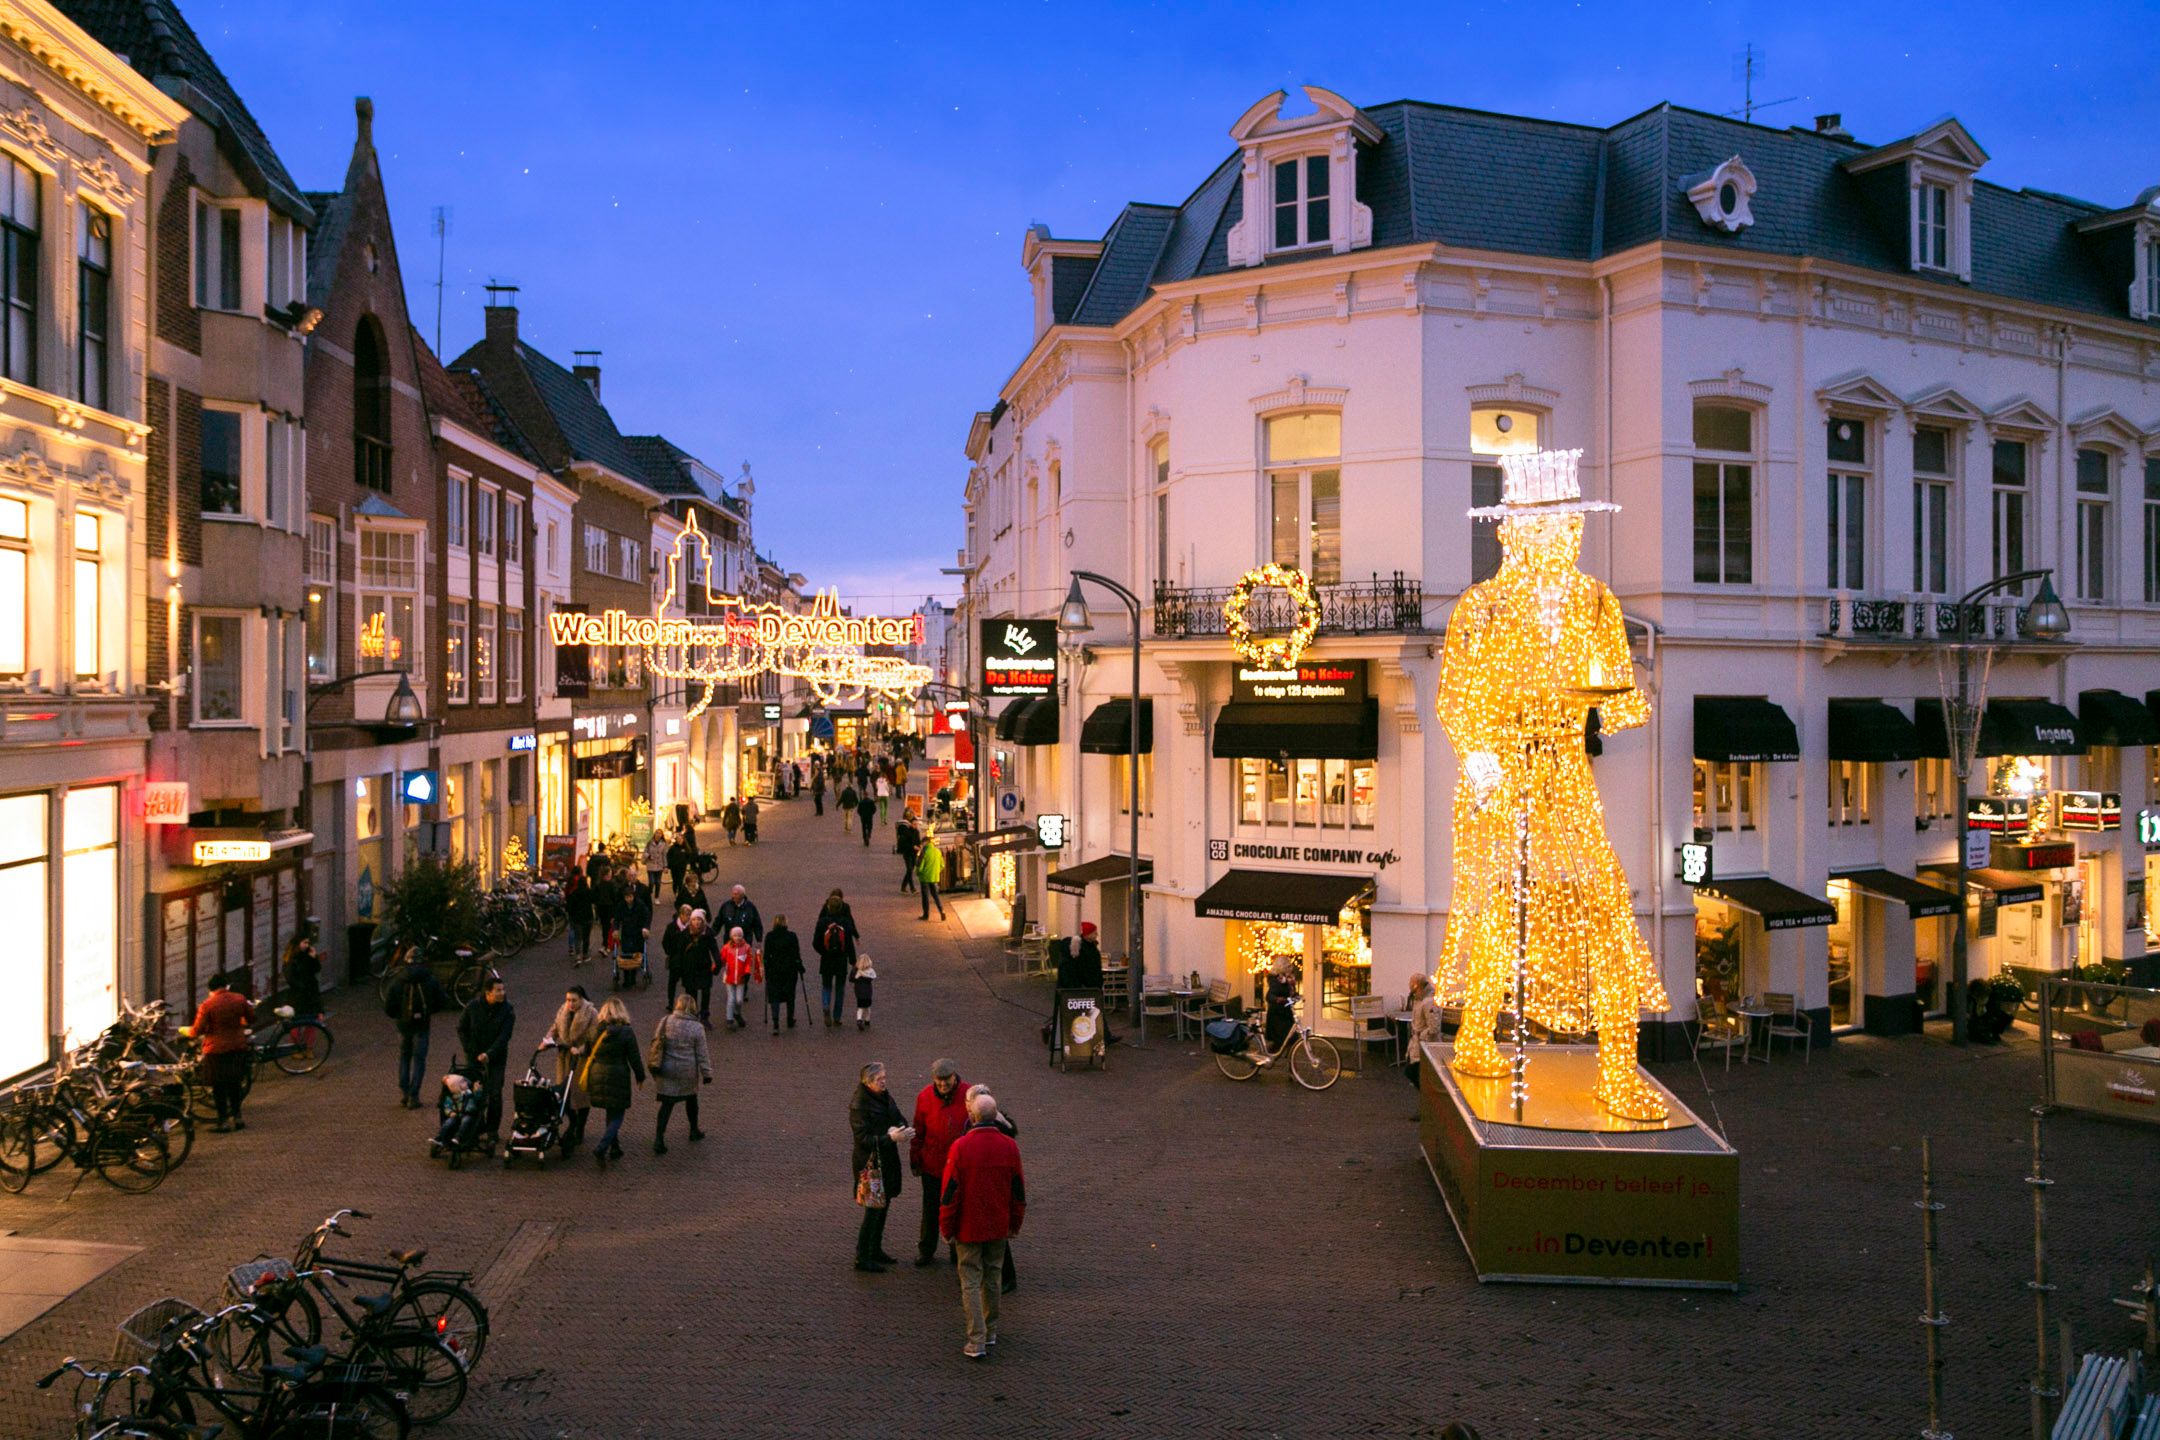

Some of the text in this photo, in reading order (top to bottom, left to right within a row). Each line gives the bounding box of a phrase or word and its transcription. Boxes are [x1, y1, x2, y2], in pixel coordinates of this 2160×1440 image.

[986, 669, 1055, 684] De Keizer
[1301, 668, 1316, 681] De
[1318, 668, 1355, 681] Keizer
[1264, 685, 1286, 699] etage
[1287, 685, 1301, 696] 125
[2035, 725, 2075, 744] Ingang
[1210, 840, 1227, 850] CH
[1211, 850, 1226, 860] CO
[1234, 844, 1400, 870] CHOCOLATE COMPANY café
[1206, 908, 1329, 923] AMAZING CHOCOLATE GREAT COFFEE
[1785, 918, 1796, 926] TEA
[1067, 1000, 1095, 1010] COFFEE
[1493, 1171, 1606, 1192] December
[1614, 1174, 1685, 1195] beleef
